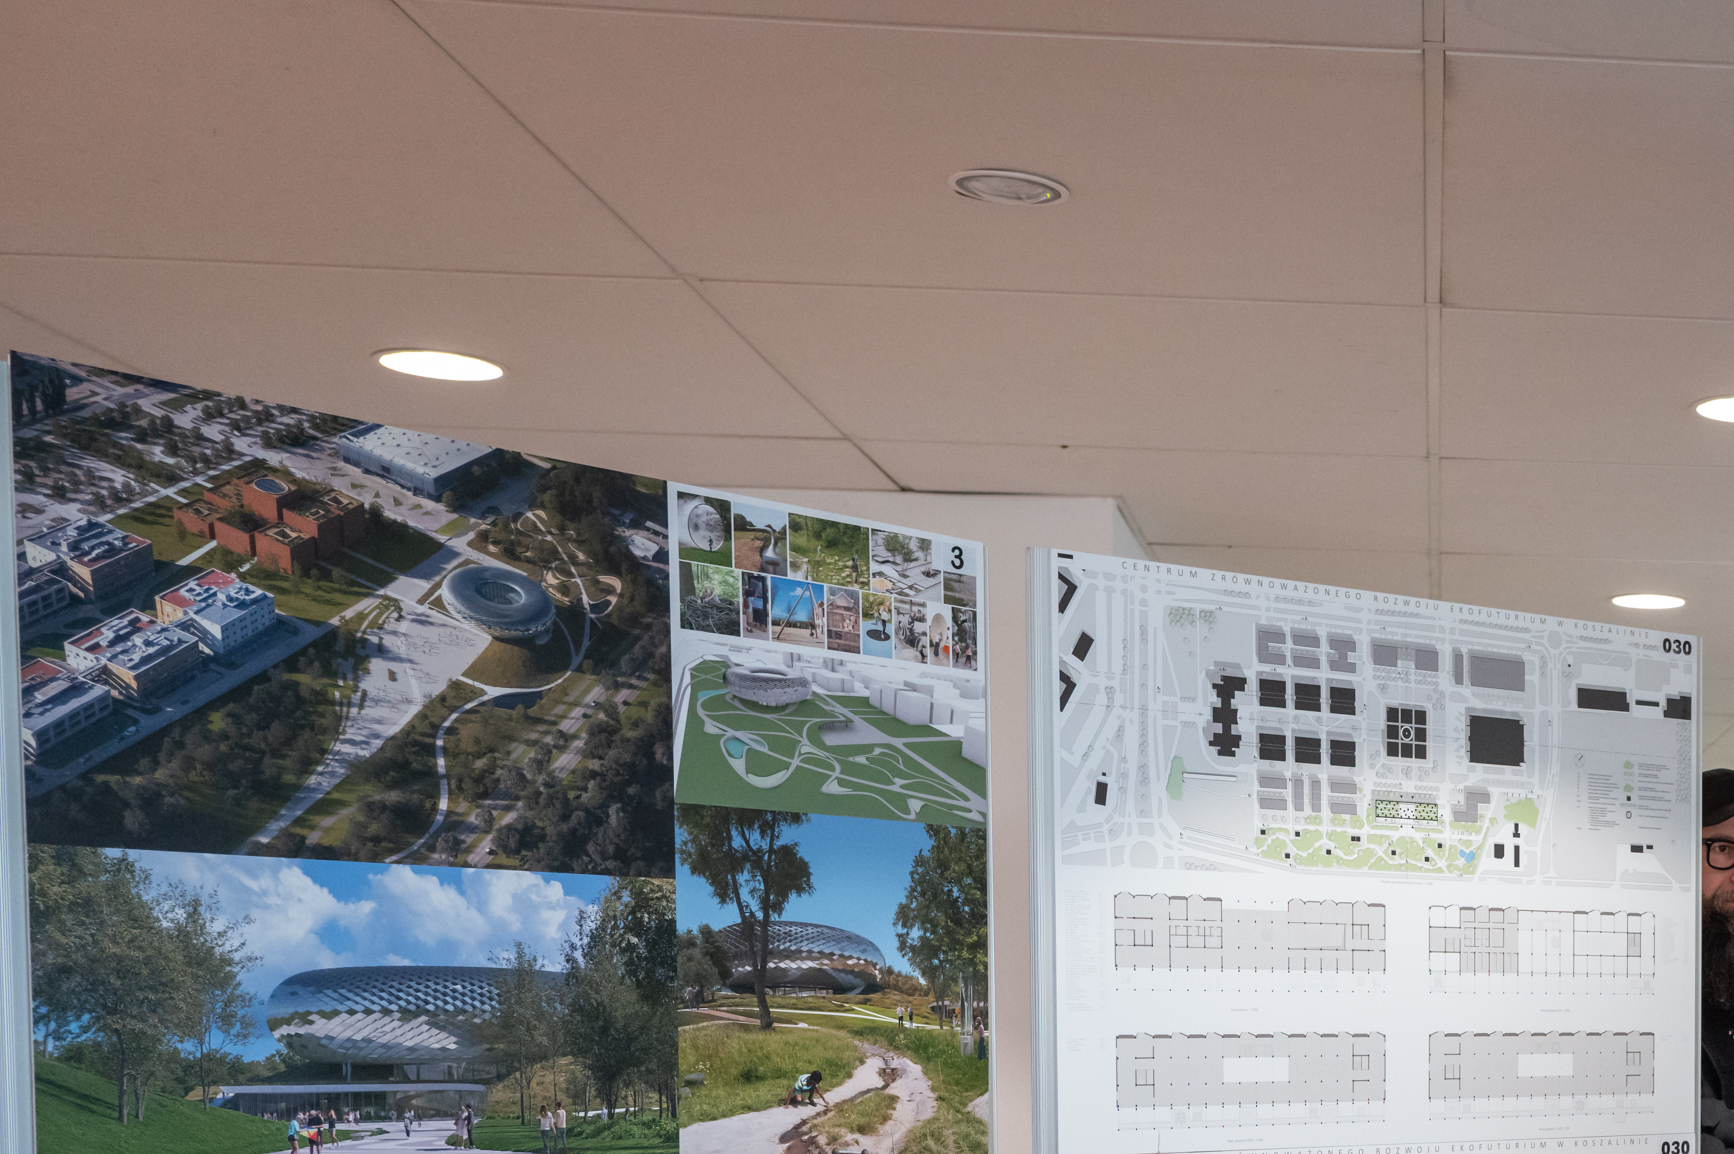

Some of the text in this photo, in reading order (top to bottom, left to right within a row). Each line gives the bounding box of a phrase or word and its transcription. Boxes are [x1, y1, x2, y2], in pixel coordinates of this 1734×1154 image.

[951, 545, 964, 570] 3
[1121, 561, 1649, 639] CENTRUM ZRÓWNOWAŻONEGO ROZWOJU EKOFUTURIUM W KOSZALINIE
[1662, 638, 1692, 656] 030
[1375, 1145, 1440, 1154] ROZWOJU
[1451, 1141, 1547, 1153] EKOFUTURIUM
[1574, 1137, 1649, 1147] KOSZALINIE
